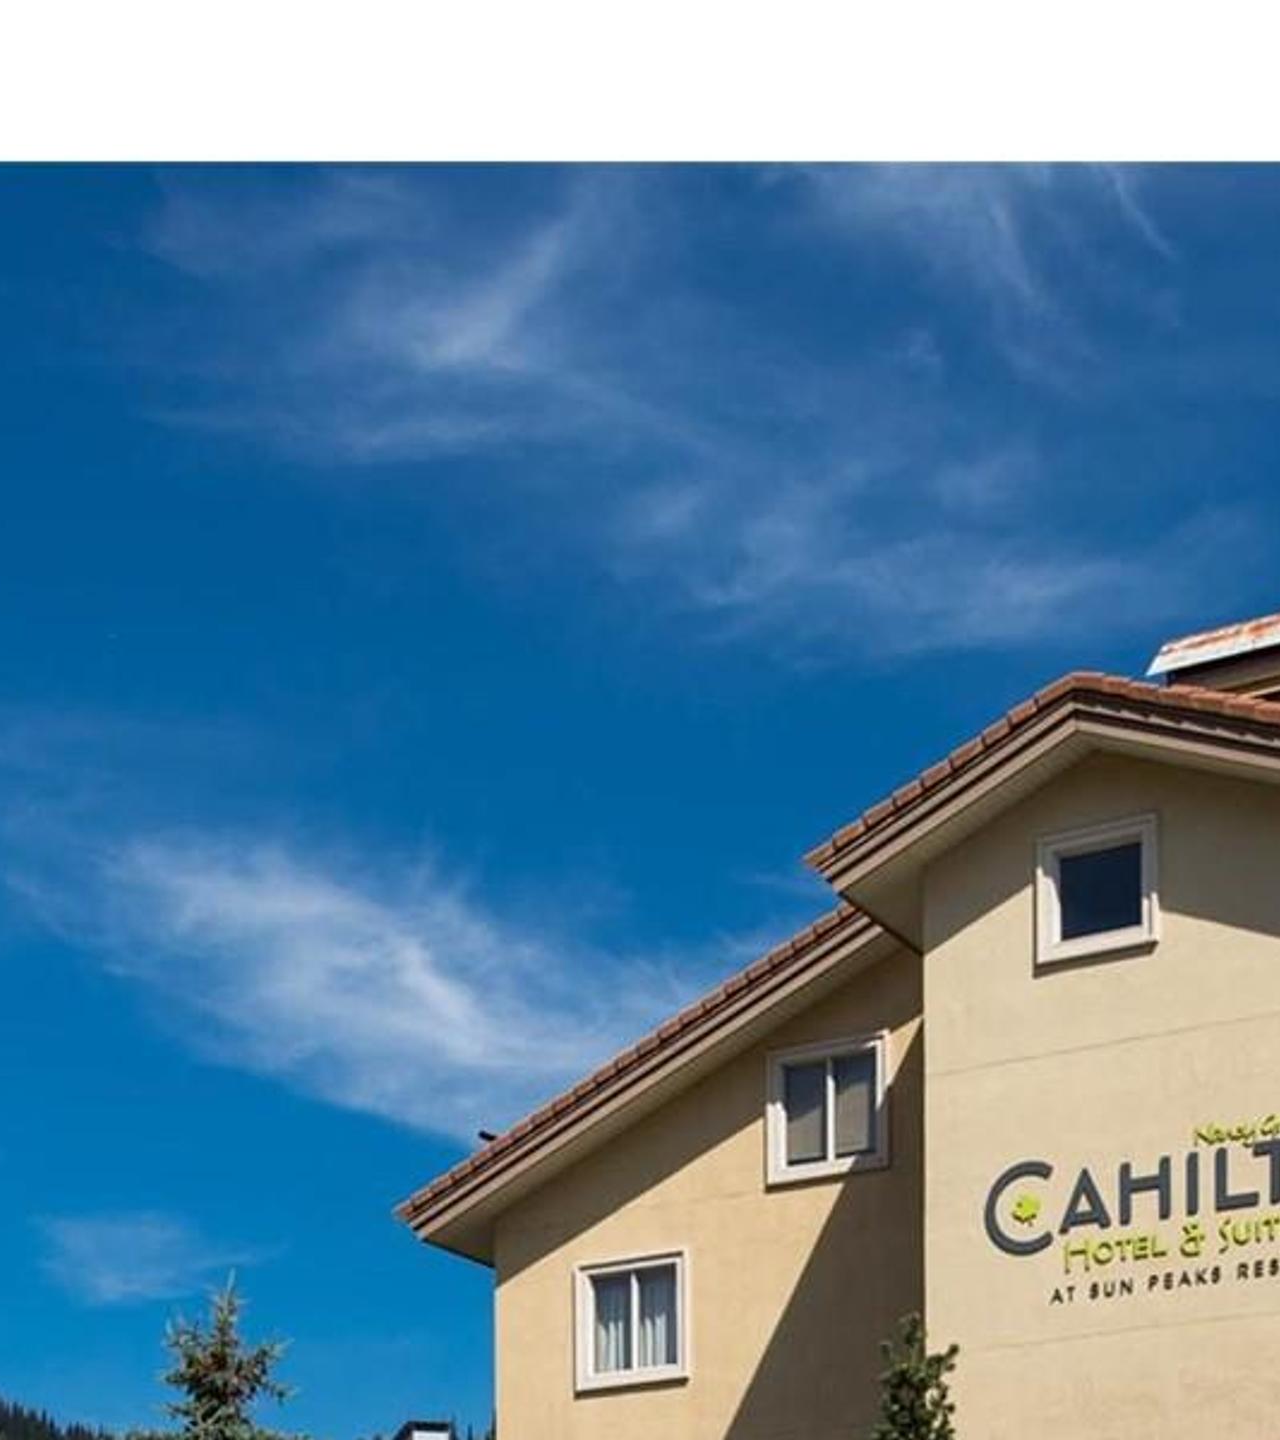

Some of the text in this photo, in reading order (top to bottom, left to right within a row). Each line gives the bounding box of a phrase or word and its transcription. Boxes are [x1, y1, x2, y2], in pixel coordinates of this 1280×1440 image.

[1063, 1234, 1168, 1275] HOTEL
[1178, 1221, 1206, 1258] &
[1048, 1285, 1076, 1305] AT
[1088, 1278, 1134, 1301] SUN
[1147, 1265, 1220, 1292] PEAKS
